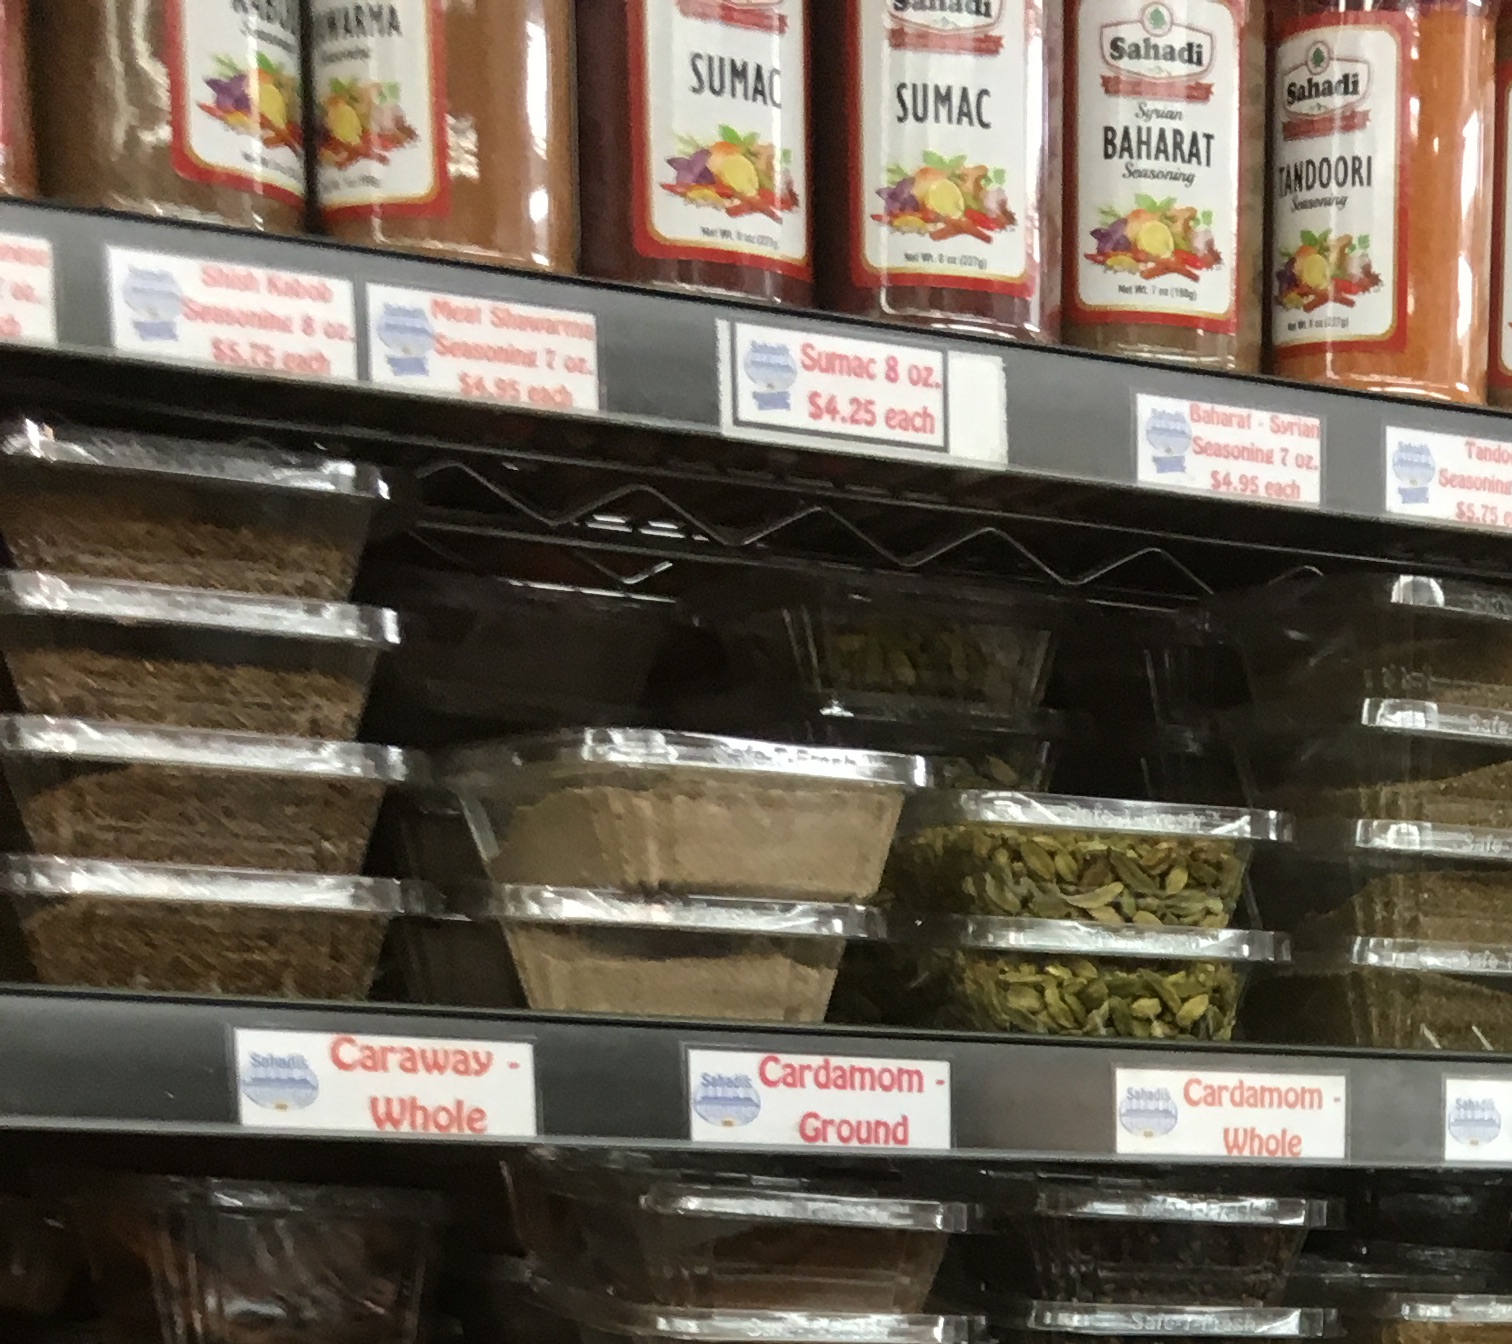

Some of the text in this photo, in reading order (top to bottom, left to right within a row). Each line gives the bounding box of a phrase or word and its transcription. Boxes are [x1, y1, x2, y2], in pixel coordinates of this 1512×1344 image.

[1109, 36, 1203, 66] Sahadi
[690, 51, 782, 109] SUMAC
[1286, 72, 1360, 105] Sahadi
[896, 82, 992, 129] SUMAC
[1135, 102, 1184, 121] Syrian
[1103, 125, 1215, 168] BAHARAT
[1121, 162, 1196, 187] Seasoning
[1279, 155, 1372, 198] TANDOORI
[1290, 195, 1348, 212] Seasoning
[800, 342, 942, 389] Sumac 8 oz.
[807, 390, 936, 435] $4.25 each
[1190, 402, 1320, 439] Baharat Syrian
[1192, 435, 1274, 465] Seasoning
[1264, 479, 1301, 500] each
[1438, 468, 1512, 496] Seasoning
[330, 1034, 494, 1077] Caraway
[759, 1054, 924, 1095] Cardamom
[1183, 1077, 1323, 1111] Cardamom
[369, 1095, 487, 1134] Whole
[800, 1112, 910, 1147] Ground
[1223, 1127, 1302, 1158] Whole
